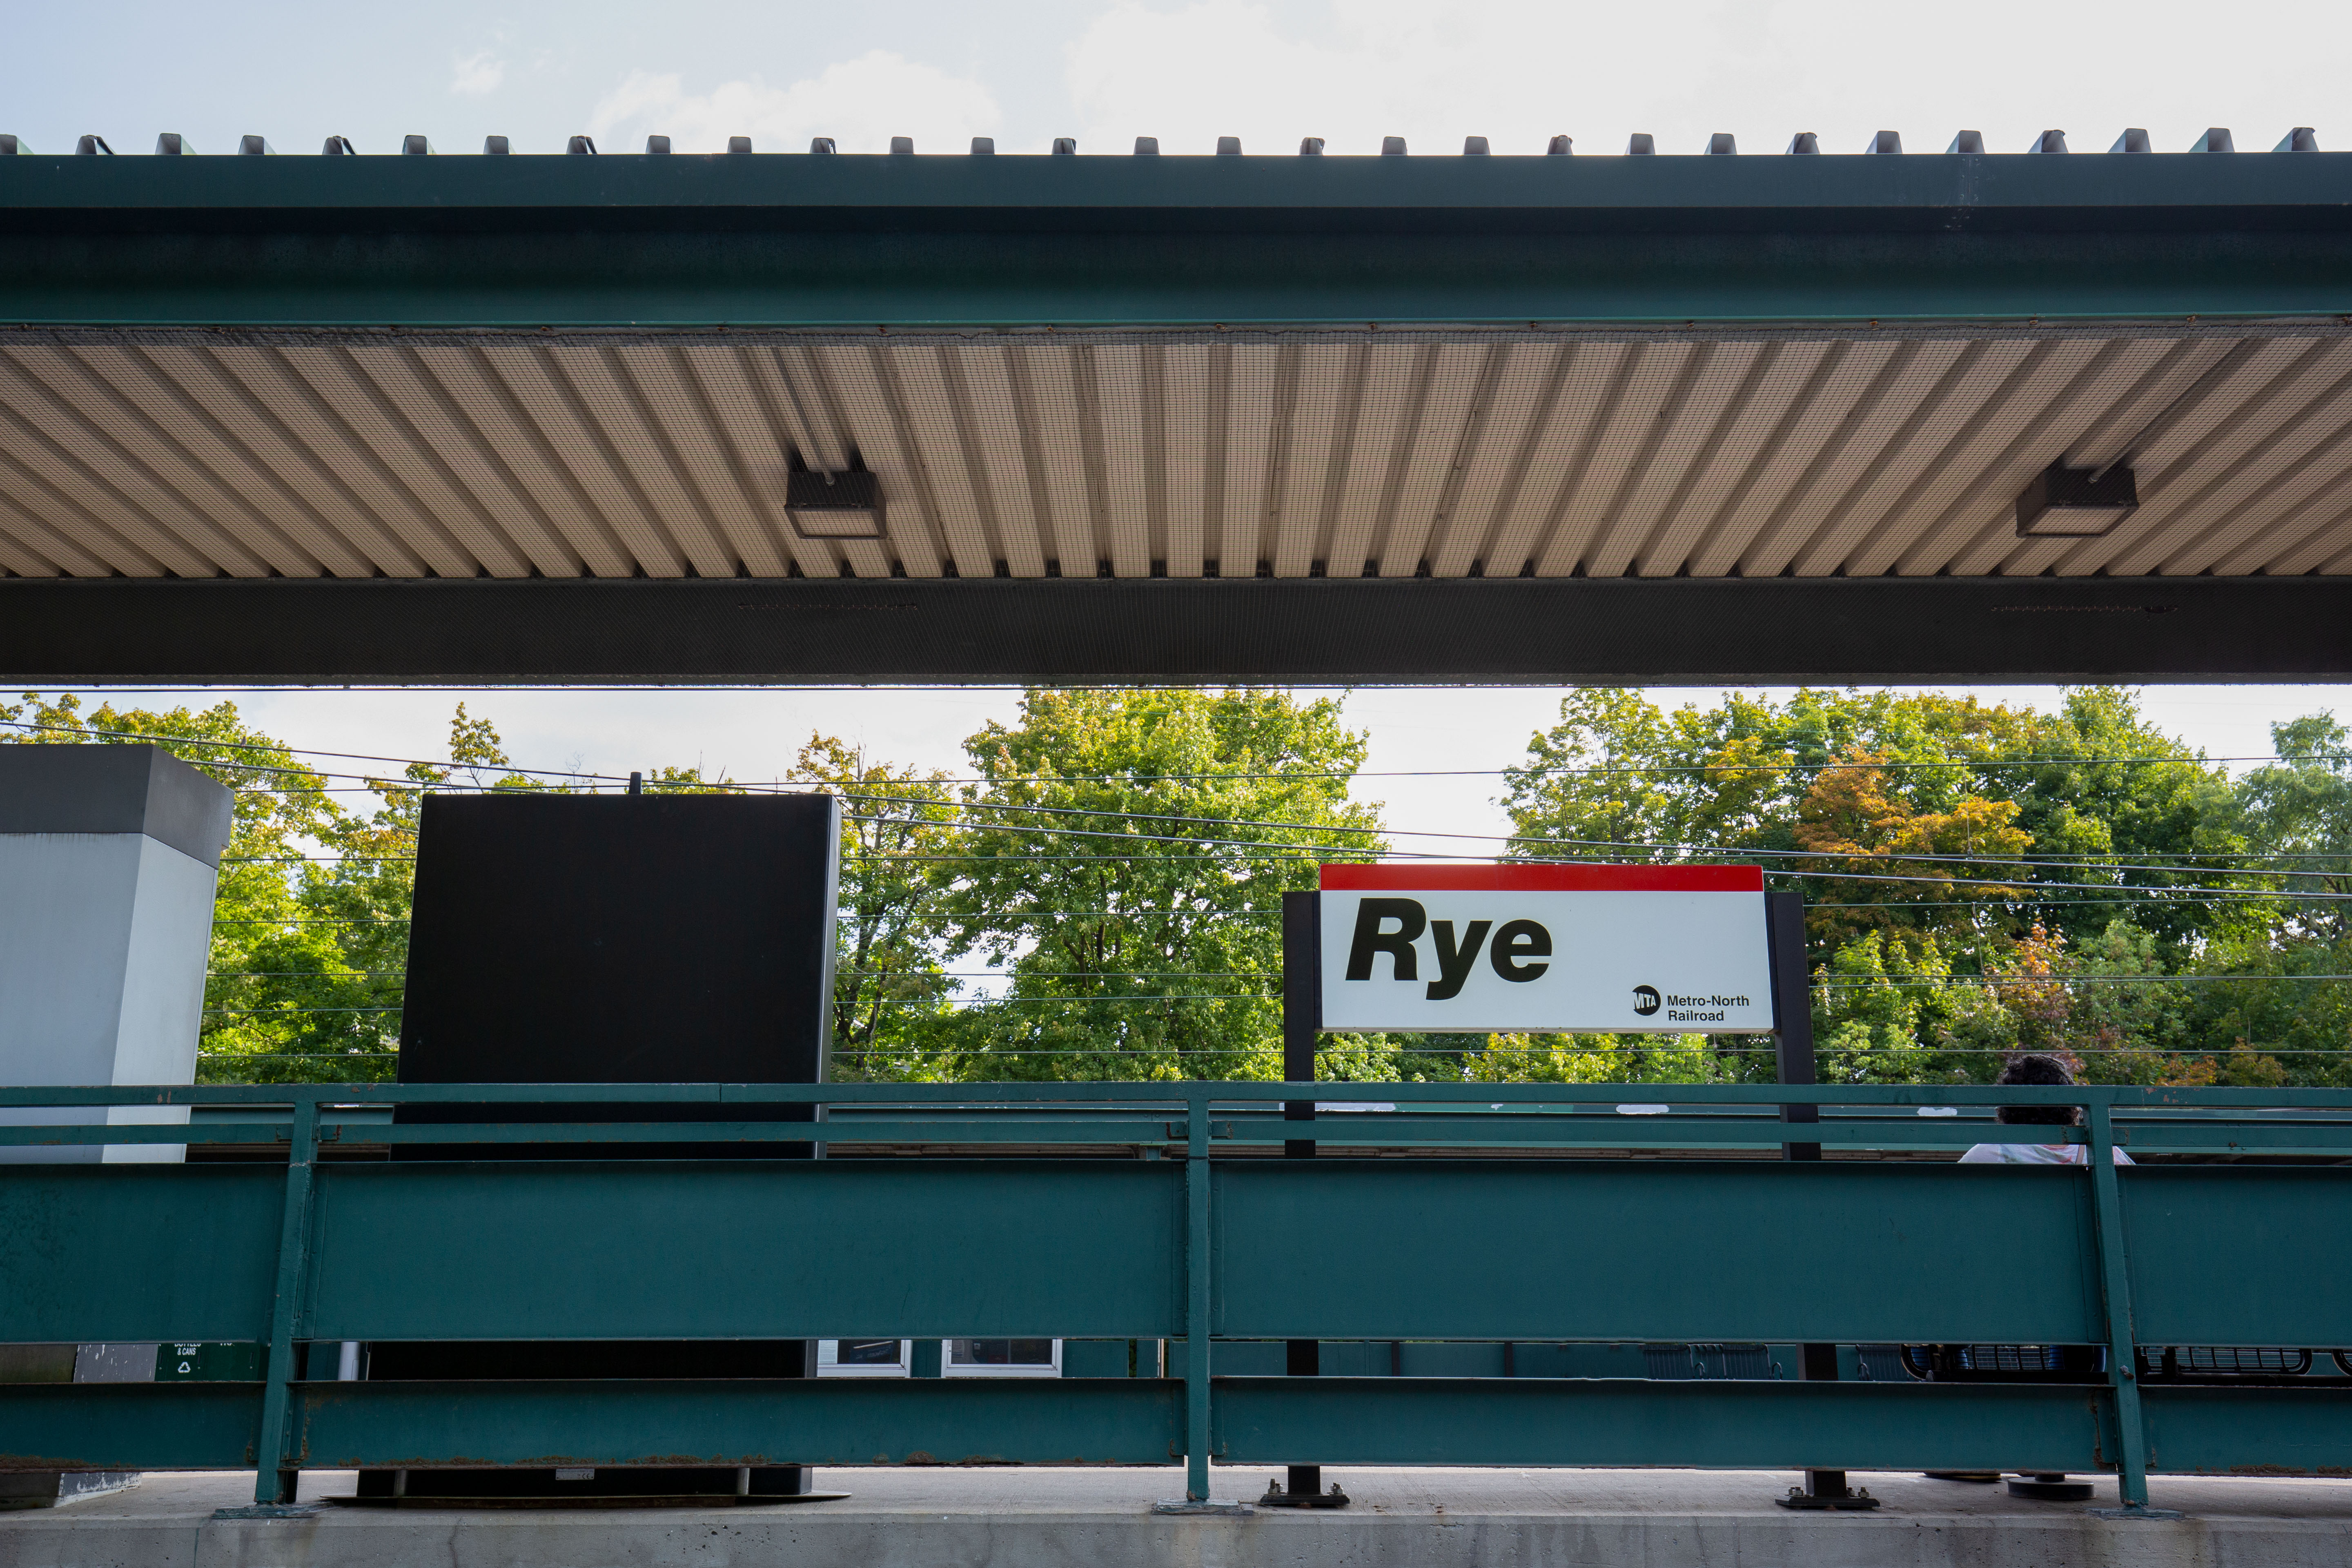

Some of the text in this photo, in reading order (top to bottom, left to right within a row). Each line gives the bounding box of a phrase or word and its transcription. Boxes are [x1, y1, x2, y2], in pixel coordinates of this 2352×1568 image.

[1345, 898, 1552, 1000] Rye
[1633, 992, 1656, 1010] MTA
[1667, 995, 1749, 1006] Metro-North
[1668, 1010, 1724, 1021] Railroad
[182, 1348, 196, 1356] CANS
